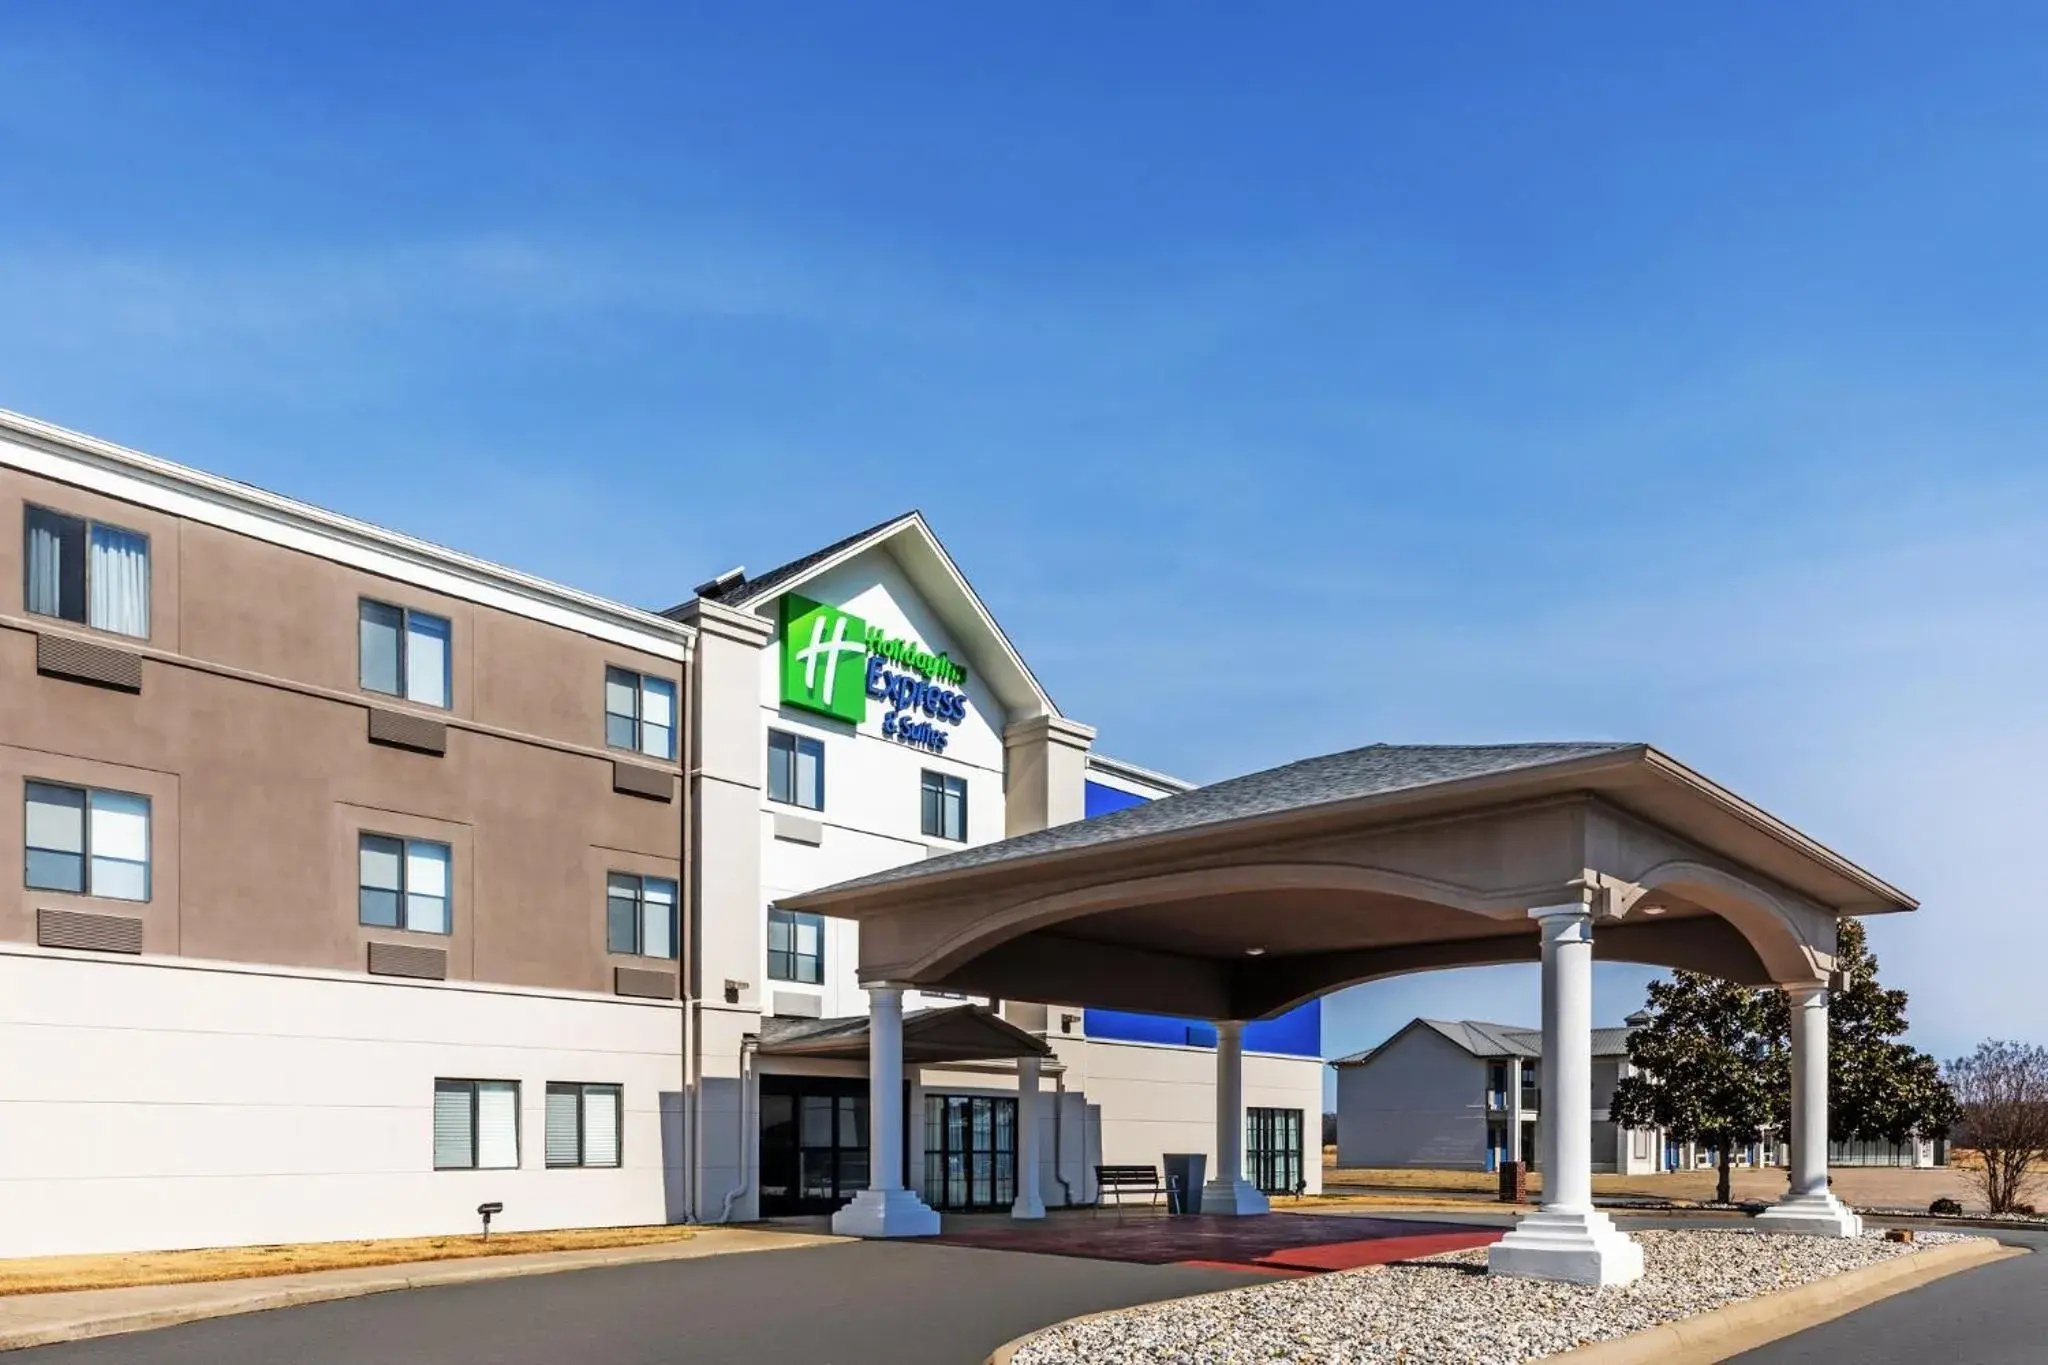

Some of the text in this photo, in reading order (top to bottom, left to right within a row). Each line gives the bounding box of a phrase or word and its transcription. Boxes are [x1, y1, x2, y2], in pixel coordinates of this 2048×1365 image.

[866, 626, 967, 685] Holiday Inn
[866, 657, 967, 723] Express
[882, 711, 948, 752] & Suites
